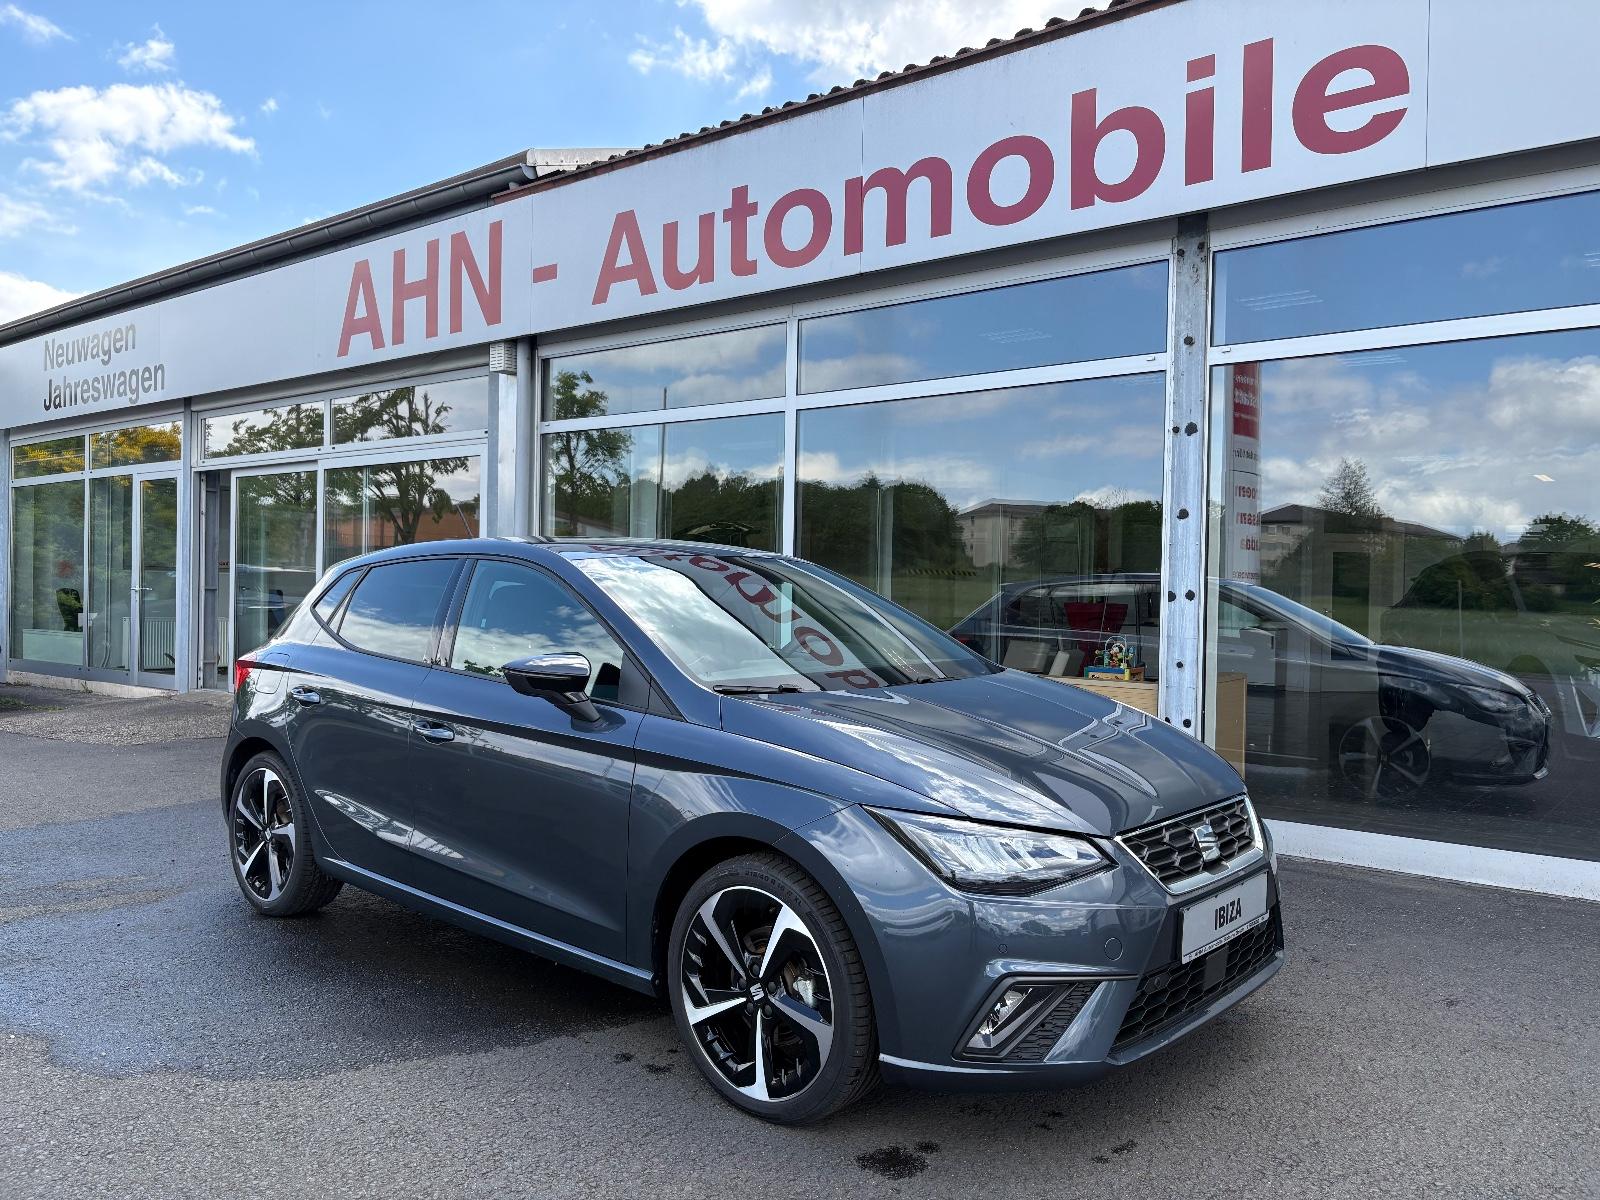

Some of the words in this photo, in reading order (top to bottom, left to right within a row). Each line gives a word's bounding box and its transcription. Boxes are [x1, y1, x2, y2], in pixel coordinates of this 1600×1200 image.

[337, 219, 503, 358] AHN
[532, 263, 558, 284] -
[591, 37, 1410, 305] Automobile
[43, 323, 137, 371] Neuwagen
[43, 363, 165, 411] Jahreswagen
[1214, 898, 1242, 931] IBIZA
